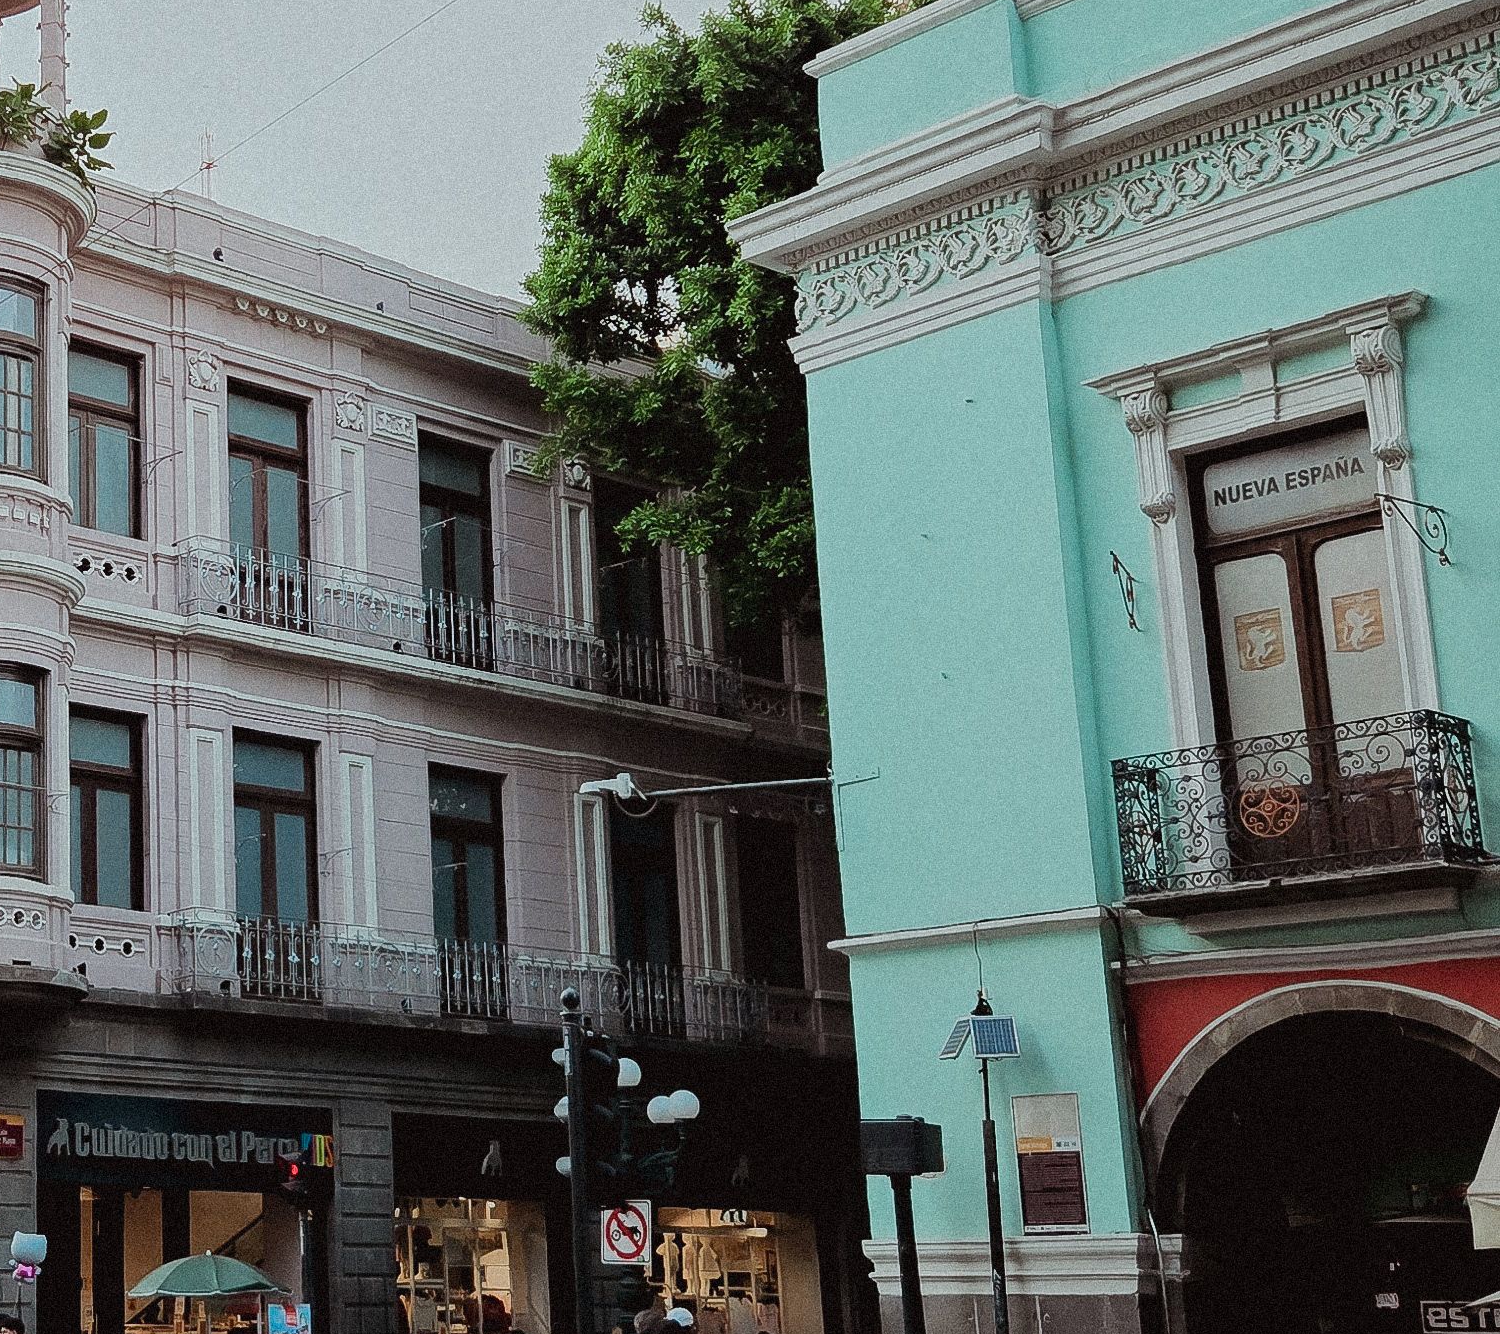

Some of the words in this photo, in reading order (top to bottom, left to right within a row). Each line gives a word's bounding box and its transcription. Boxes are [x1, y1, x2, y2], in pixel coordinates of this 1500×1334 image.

[1213, 477, 1280, 506] NUEVA
[1285, 456, 1365, 491] ESPAÑA
[74, 1122, 169, 1160] Cuidado
[172, 1132, 215, 1169] con
[215, 1130, 237, 1163] el
